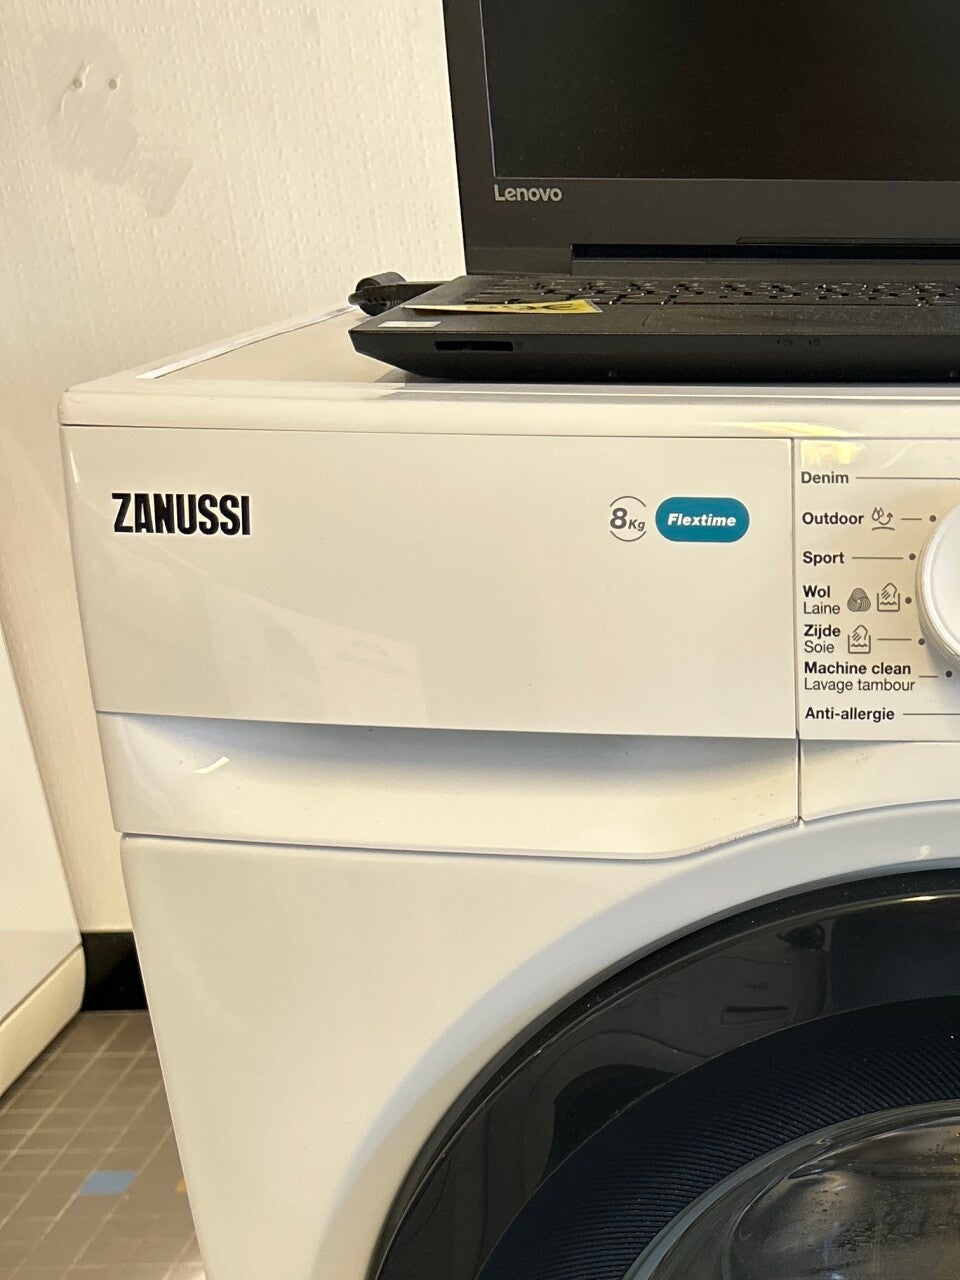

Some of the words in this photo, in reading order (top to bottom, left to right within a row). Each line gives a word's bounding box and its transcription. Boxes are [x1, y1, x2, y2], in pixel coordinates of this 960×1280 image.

[494, 184, 562, 201] Lenovo
[800, 472, 849, 484] Denim
[112, 493, 250, 535] ZANUSSI
[610, 508, 627, 529] 8
[628, 519, 645, 531] Kg
[668, 513, 736, 526] Flextime
[802, 512, 863, 525] Outdoor
[803, 552, 845, 566] Sport
[803, 586, 831, 598] Wol
[803, 602, 840, 615] Laine
[804, 624, 841, 640] Zijde
[804, 641, 834, 653] Soie
[804, 662, 867, 676] Machine
[871, 662, 911, 675] clean
[804, 679, 853, 695] Lavage
[857, 679, 915, 692] tambour
[805, 707, 895, 724] Anti-allergie
